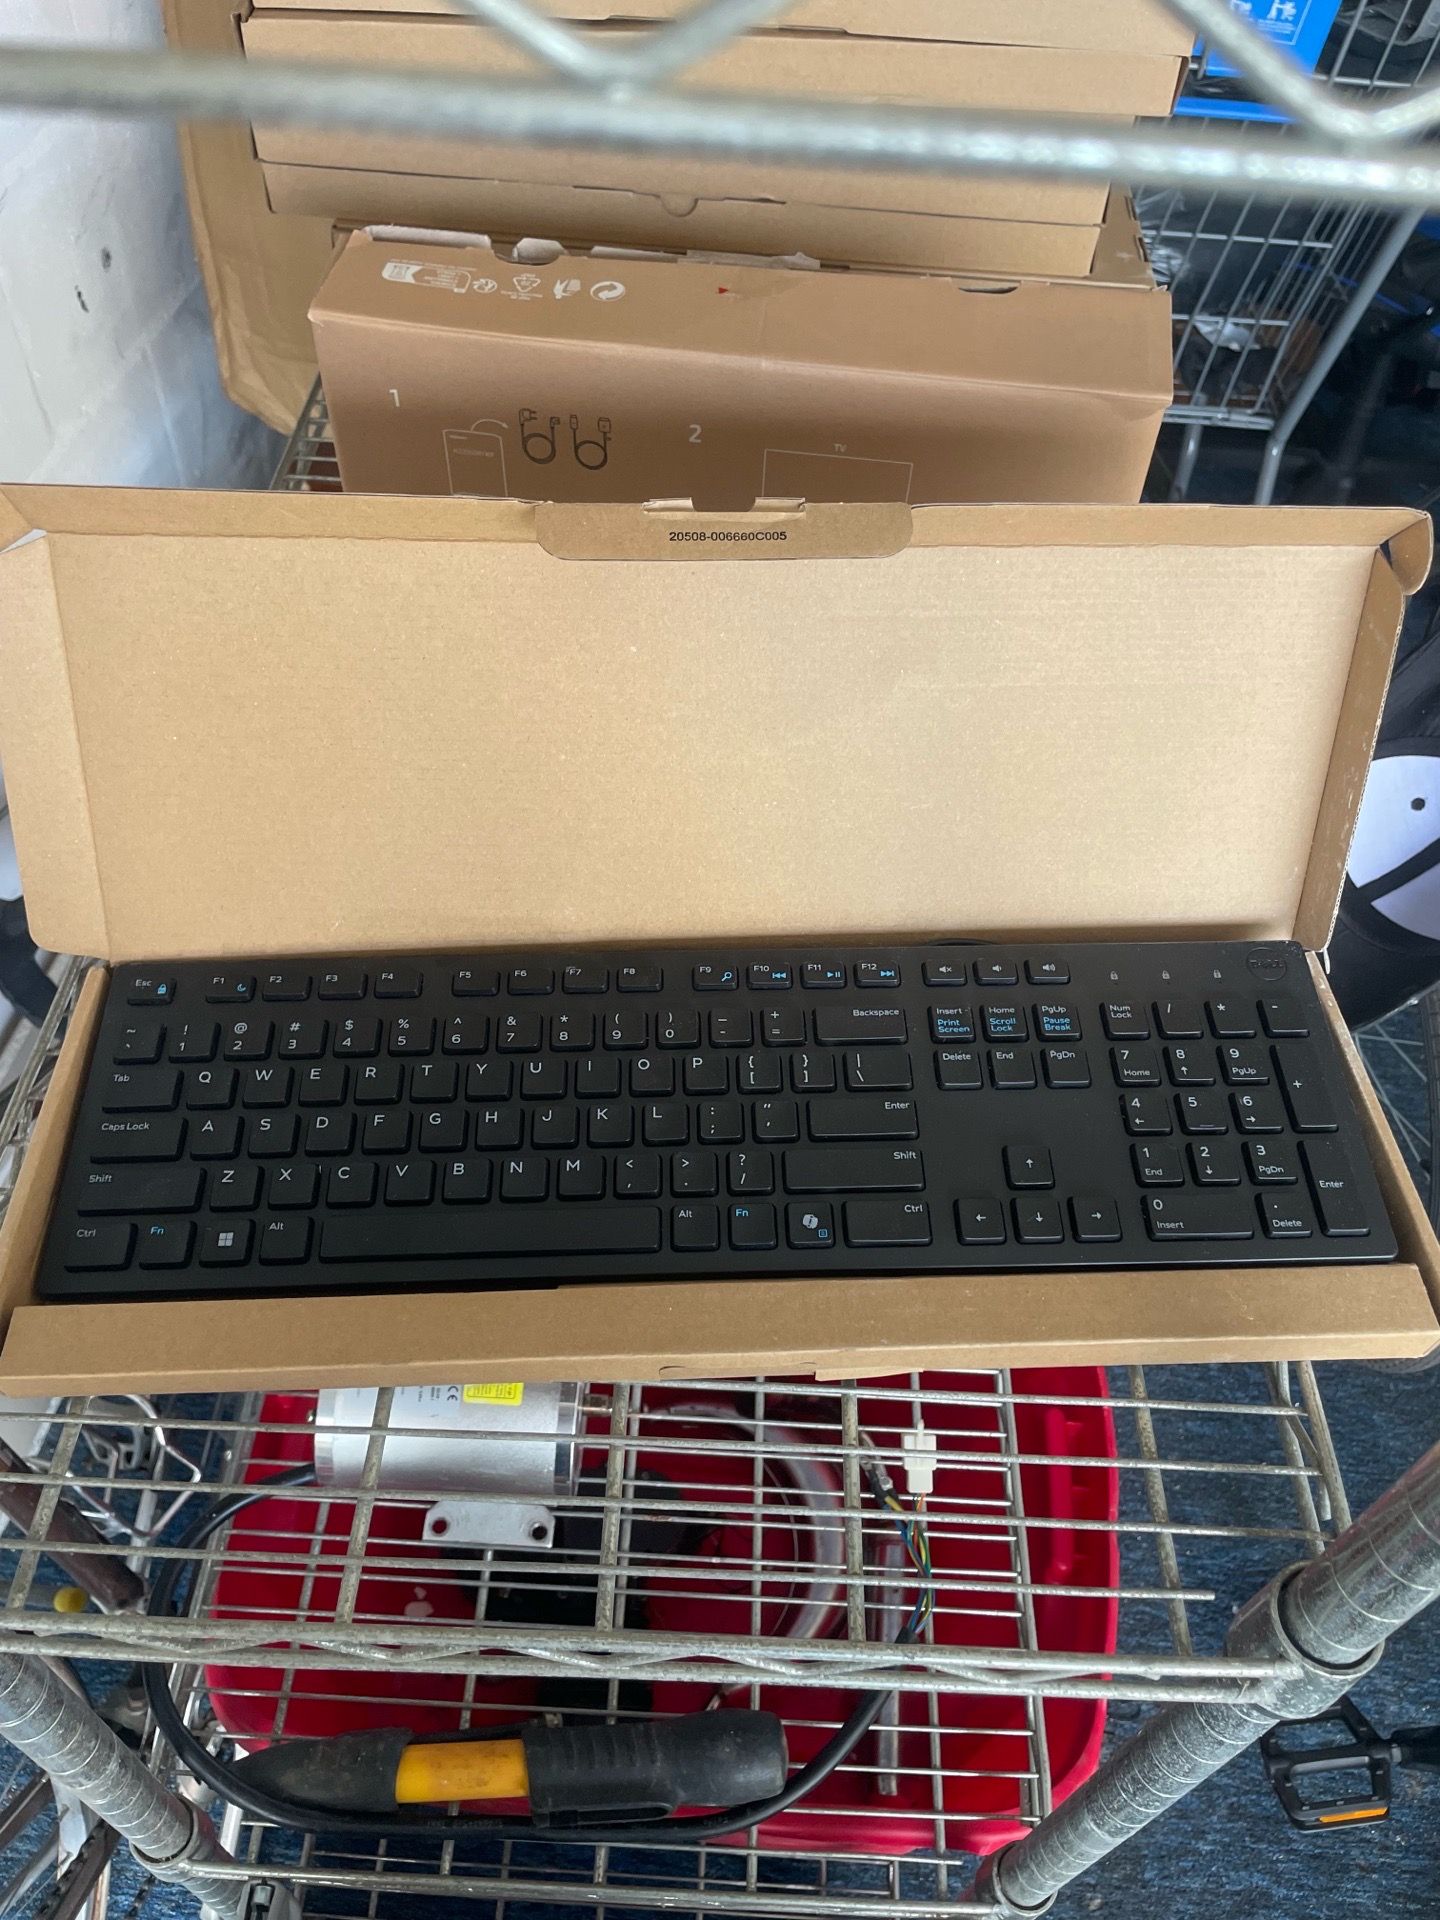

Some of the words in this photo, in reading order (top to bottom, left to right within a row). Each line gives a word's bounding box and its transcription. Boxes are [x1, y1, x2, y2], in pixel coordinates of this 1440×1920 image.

[389, 389, 400, 407] 1
[689, 425, 702, 443] 2
[669, 531, 788, 542] 20508-006660C005
[568, 966, 582, 976] F7
[623, 967, 636, 975] F8
[861, 963, 877, 971] F12
[325, 974, 338, 982] F3
[381, 972, 394, 980] F4
[459, 971, 472, 979] F5
[514, 969, 528, 977] F6
[135, 979, 153, 987] Esc
[212, 977, 225, 985] F1
[269, 975, 282, 983] F2
[852, 1008, 900, 1018] Backspace
[936, 1007, 963, 1015] Insert
[1041, 1005, 1067, 1014] PgUp
[1167, 1003, 1171, 1014] /
[615, 1013, 620, 1025] (
[668, 1012, 673, 1023] )
[770, 1010, 780, 1019] +
[344, 1019, 354, 1031] $
[398, 1018, 410, 1029] %
[506, 1015, 517, 1026] &
[183, 1024, 188, 1035] !
[234, 1022, 248, 1034] @
[289, 1022, 301, 1032] #
[451, 1033, 461, 1044] 6
[507, 1032, 515, 1042] 7
[559, 1031, 569, 1041] 8
[611, 1029, 622, 1040] 9
[665, 1029, 675, 1039] 0
[232, 1040, 243, 1051] 2
[288, 1039, 297, 1049] 3
[342, 1037, 351, 1047] 4
[397, 1035, 407, 1046] 5
[179, 1042, 185, 1051] 1
[942, 1051, 972, 1061] Delete
[995, 1051, 1014, 1060] End
[1049, 1049, 1076, 1060] PgDn
[1120, 1049, 1129, 1060] 7
[1175, 1049, 1186, 1059] 8
[1229, 1048, 1240, 1058] 9
[588, 1060, 592, 1072] I
[637, 1058, 650, 1070] O
[692, 1057, 703, 1069] P
[748, 1055, 754, 1069] {
[802, 1054, 809, 1068] }
[365, 1066, 377, 1078] R
[421, 1064, 433, 1076] T
[476, 1063, 488, 1075] Y
[530, 1062, 542, 1074] U
[1123, 1068, 1151, 1076] Home
[1231, 1067, 1257, 1076] PgUp
[113, 1073, 130, 1082] Tab
[198, 1071, 212, 1084] Q
[255, 1069, 273, 1081] W
[309, 1068, 322, 1080] E
[749, 1071, 755, 1085] [
[803, 1070, 809, 1083] ]
[856, 1069, 864, 1082] \
[1292, 1079, 1303, 1089] +
[884, 1101, 910, 1110] Enter
[1131, 1097, 1141, 1108] 4
[1188, 1096, 1198, 1107] 5
[1242, 1095, 1253, 1107] 6
[485, 1111, 498, 1123] H
[541, 1109, 552, 1122] J
[597, 1108, 609, 1120] K
[652, 1106, 663, 1118] L
[315, 1116, 329, 1129] D
[373, 1114, 385, 1127] F
[429, 1112, 441, 1125] G
[101, 1122, 126, 1132] Caps
[126, 1121, 150, 1131] Lock
[201, 1119, 214, 1132] A
[259, 1118, 271, 1131] S
[893, 1150, 917, 1160] Shift
[1142, 1147, 1150, 1158] 1
[1199, 1146, 1211, 1157] 2
[1256, 1144, 1266, 1156] 3
[626, 1159, 634, 1168] <
[681, 1158, 690, 1168] >
[738, 1153, 746, 1166] ?
[395, 1164, 409, 1177] V
[452, 1162, 465, 1175] B
[509, 1161, 523, 1174] N
[566, 1159, 581, 1172] M
[1258, 1165, 1285, 1175] PgDn
[221, 1169, 235, 1183] Z
[278, 1168, 292, 1181] X
[337, 1166, 351, 1179] C
[1144, 1168, 1163, 1176] End
[88, 1174, 112, 1183] Shift
[740, 1172, 746, 1185] /
[1318, 1180, 1344, 1188] Enter
[904, 1204, 923, 1213] Ctrl
[1153, 1199, 1163, 1211] 0
[678, 1209, 693, 1218] Alt
[735, 1208, 749, 1217] Fn
[269, 1221, 284, 1231] Alt
[1156, 1220, 1185, 1229] Insert
[1272, 1219, 1302, 1228] Delete
[76, 1228, 97, 1238] Ctrl
[150, 1226, 164, 1235] Fn
